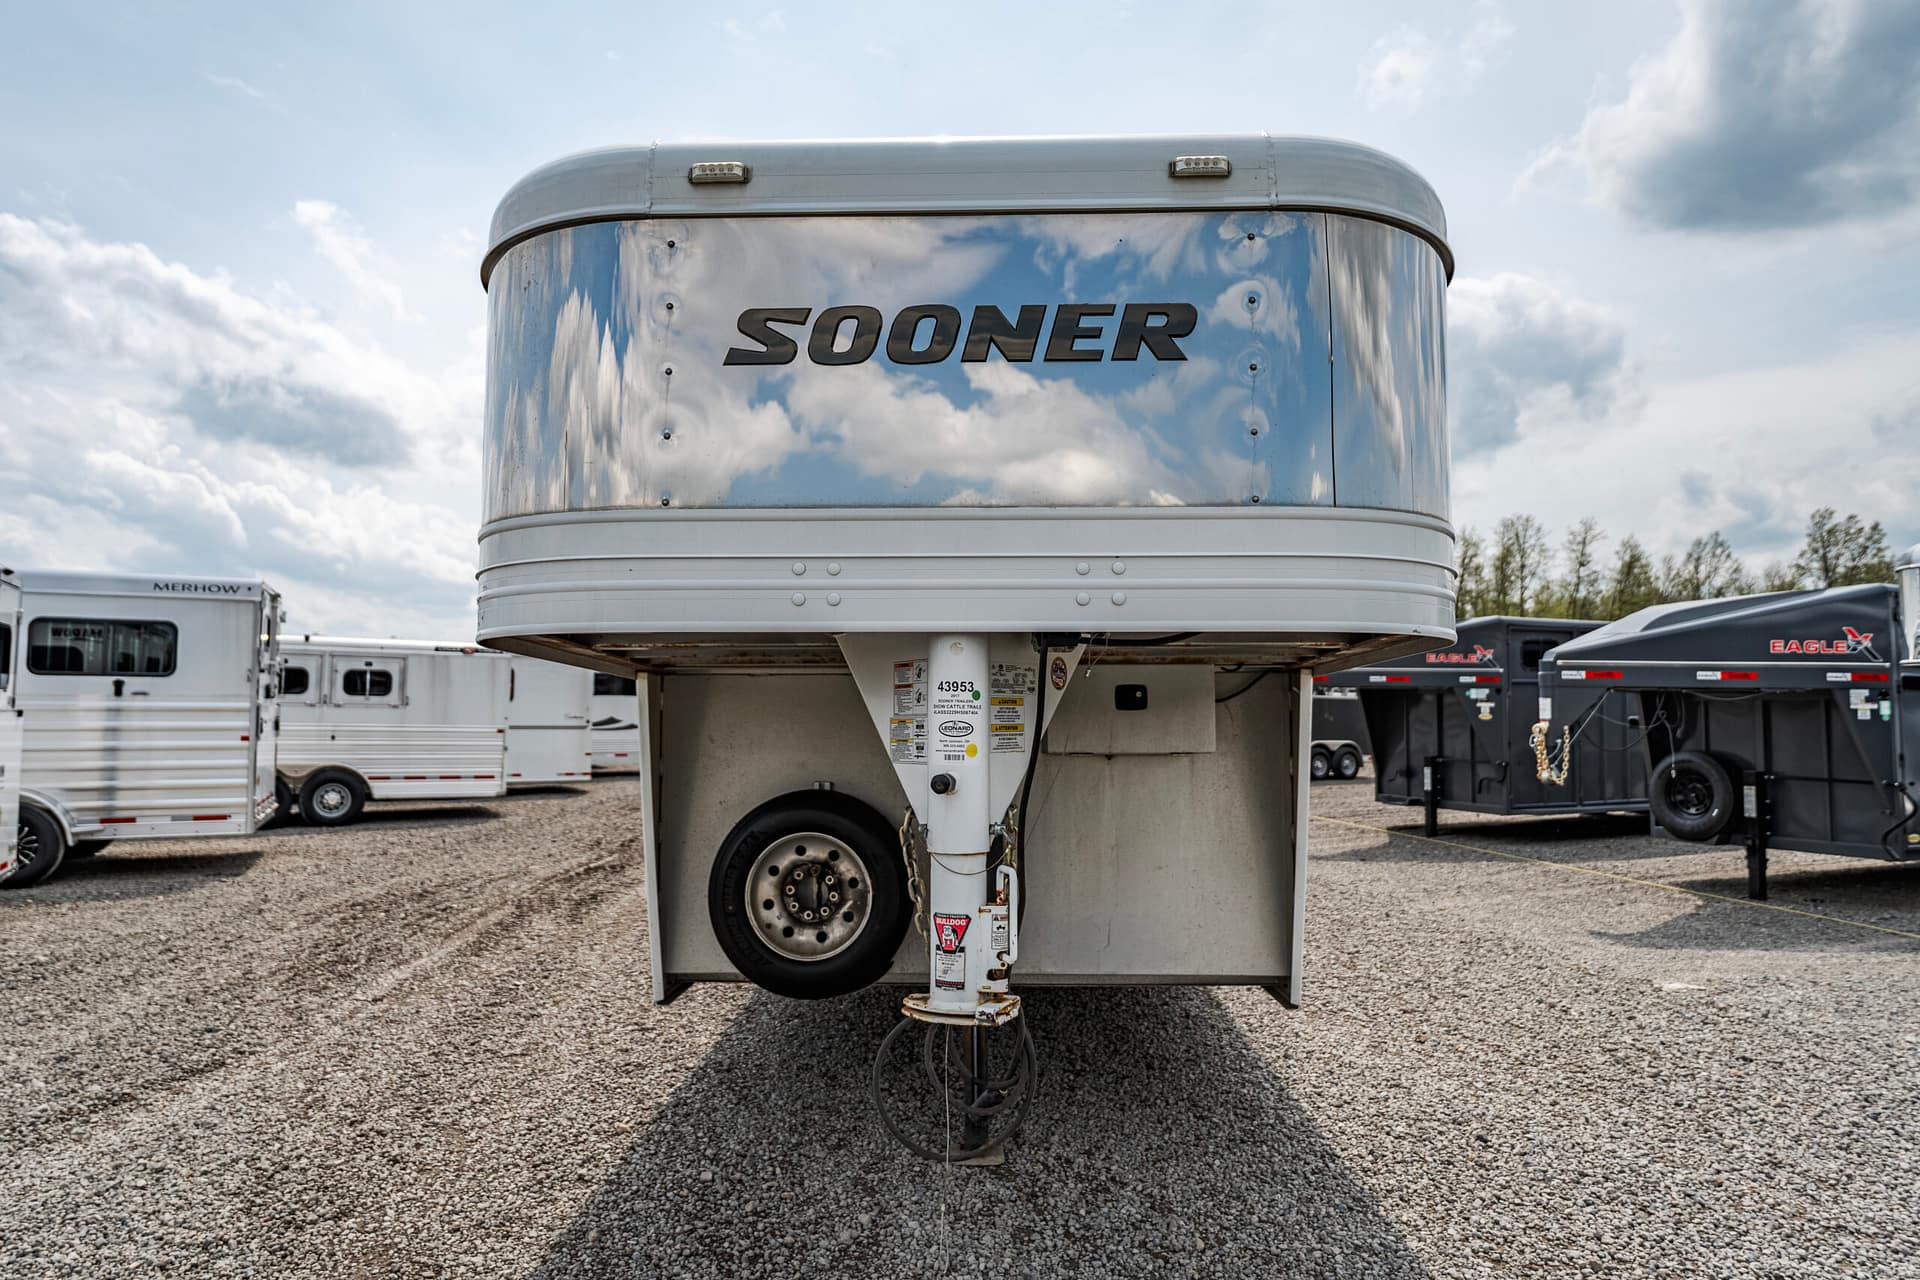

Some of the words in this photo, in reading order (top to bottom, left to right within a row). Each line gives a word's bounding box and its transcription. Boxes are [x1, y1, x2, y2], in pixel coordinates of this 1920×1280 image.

[723, 303, 1198, 366] SOONER
[153, 582, 240, 594] MERHOW
[937, 681, 974, 692] 43953
[936, 917, 966, 926] BULLDOG
